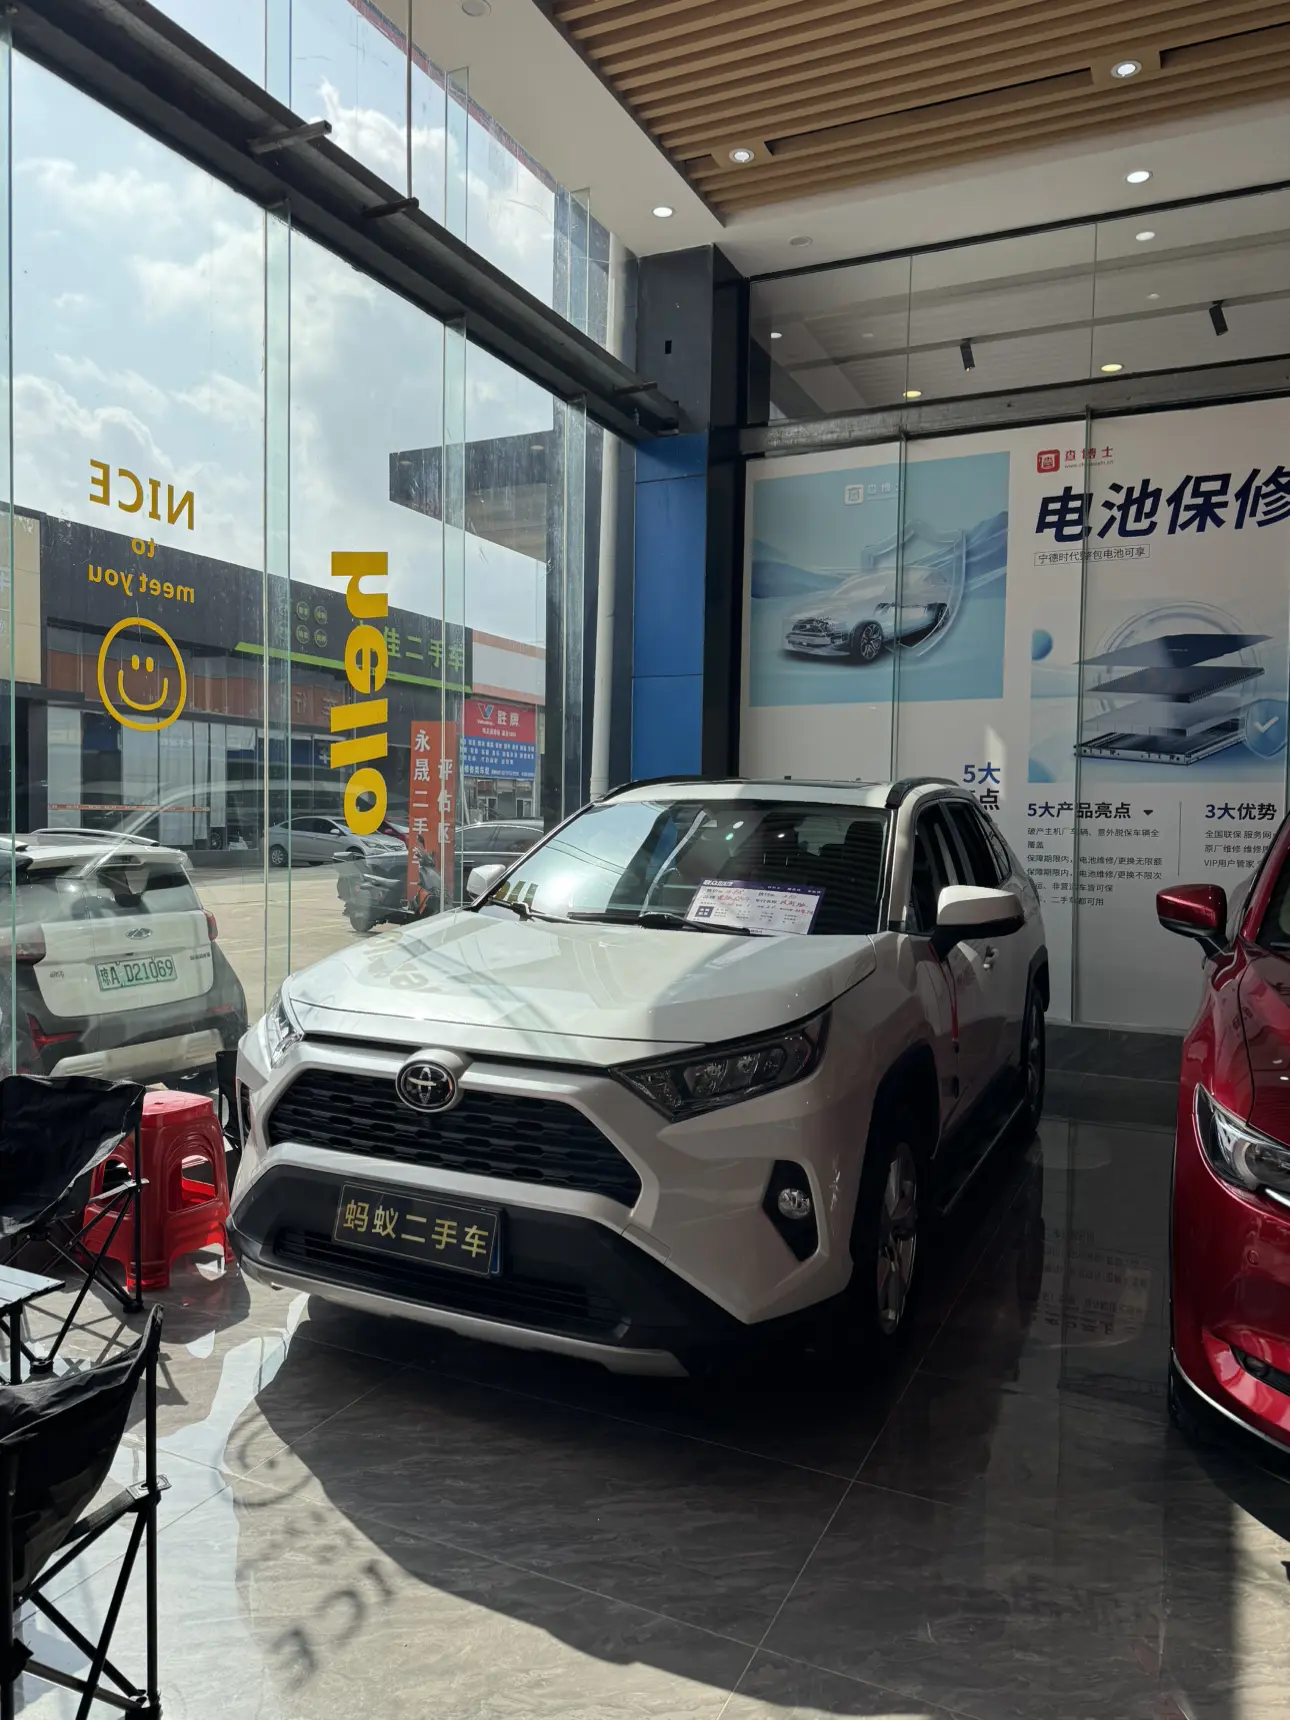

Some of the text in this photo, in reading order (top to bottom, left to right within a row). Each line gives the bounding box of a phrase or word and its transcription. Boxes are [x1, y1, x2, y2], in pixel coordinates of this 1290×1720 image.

[1035, 466, 1290, 543] 电池保修
[358, 621, 465, 672] 佳二手车
[963, 762, 1000, 784] 5大
[970, 788, 1000, 811] 点
[1027, 802, 1132, 819] 5大产品亮点
[1205, 803, 1277, 820] 3大优势
[1205, 830, 1275, 839] 全国联保 服务网
[1204, 844, 1241, 853] 原厂维修
[1204, 859, 1255, 868] VIP用户管家
[124, 959, 173, 982] D21069
[343, 1200, 489, 1258] 蚂蚁二手车
